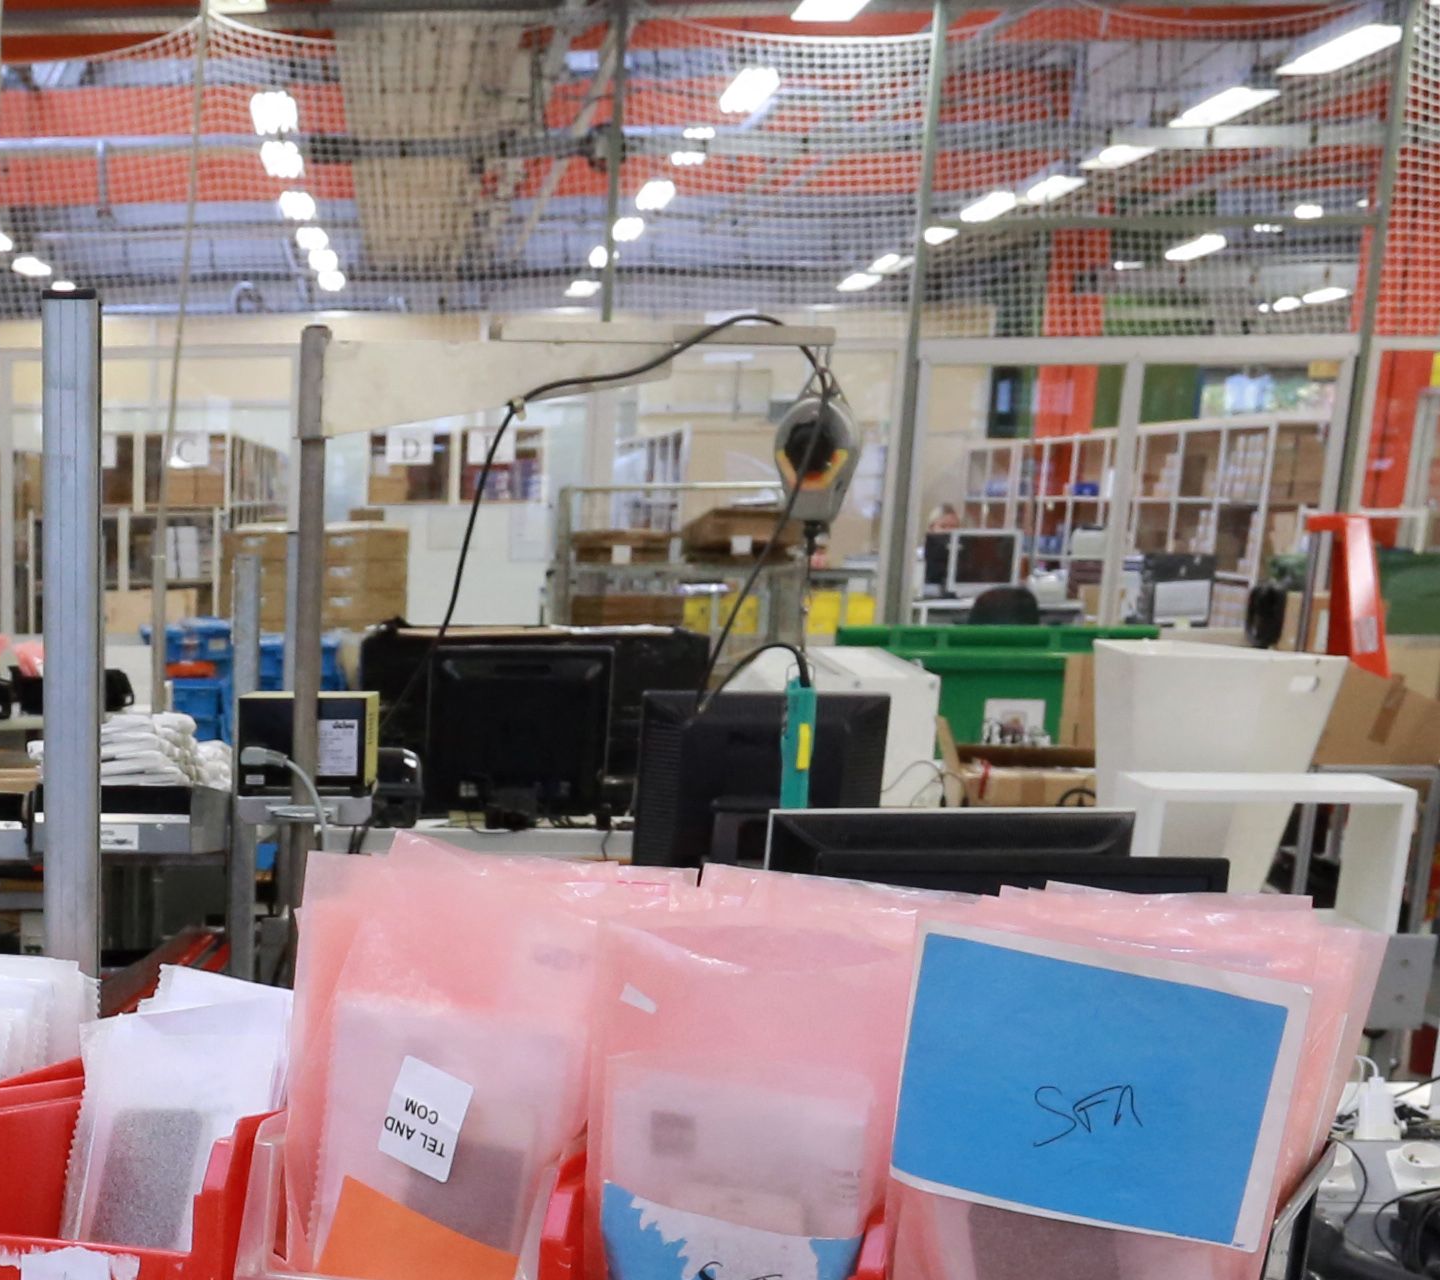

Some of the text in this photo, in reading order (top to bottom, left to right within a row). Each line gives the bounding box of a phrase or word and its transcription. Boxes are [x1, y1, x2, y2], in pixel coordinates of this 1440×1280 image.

[175, 438, 197, 463] C
[401, 438, 421, 460] D
[404, 1098, 439, 1125] COM
[383, 1116, 446, 1158] TEL AND
